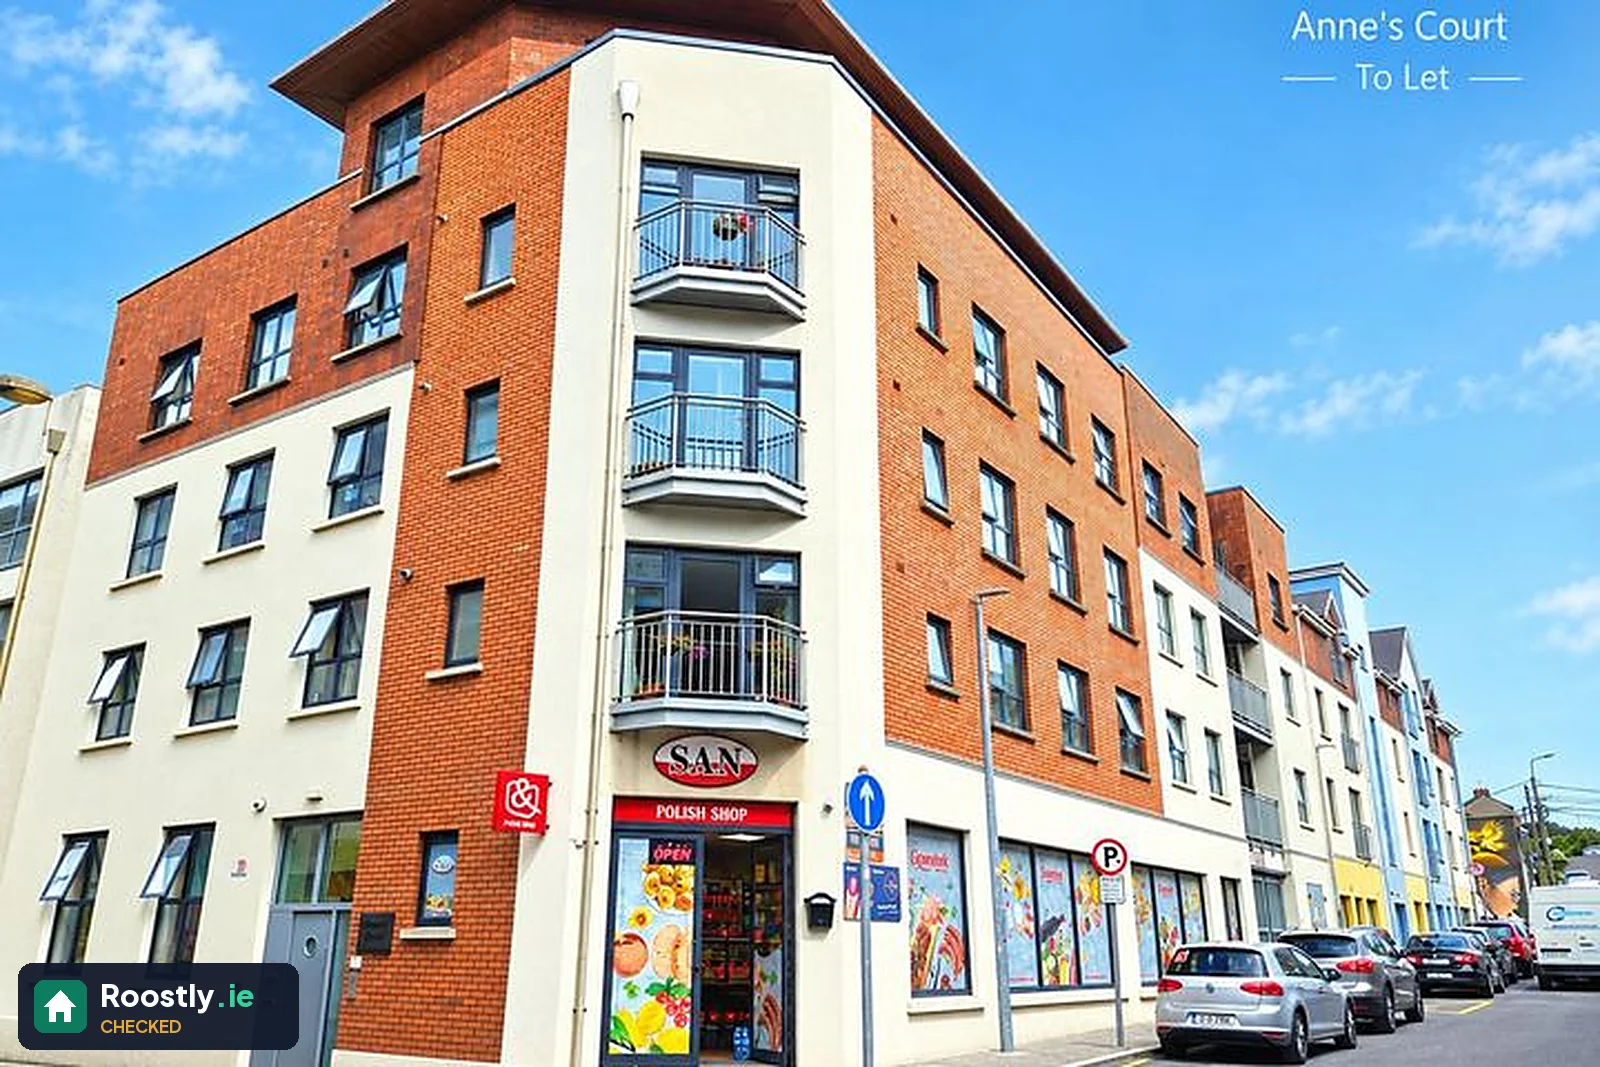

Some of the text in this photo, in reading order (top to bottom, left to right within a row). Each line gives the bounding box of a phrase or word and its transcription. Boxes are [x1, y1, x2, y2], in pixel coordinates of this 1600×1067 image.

[656, 805, 748, 822] POLISH SHOP
[653, 847, 693, 861] OPEN
